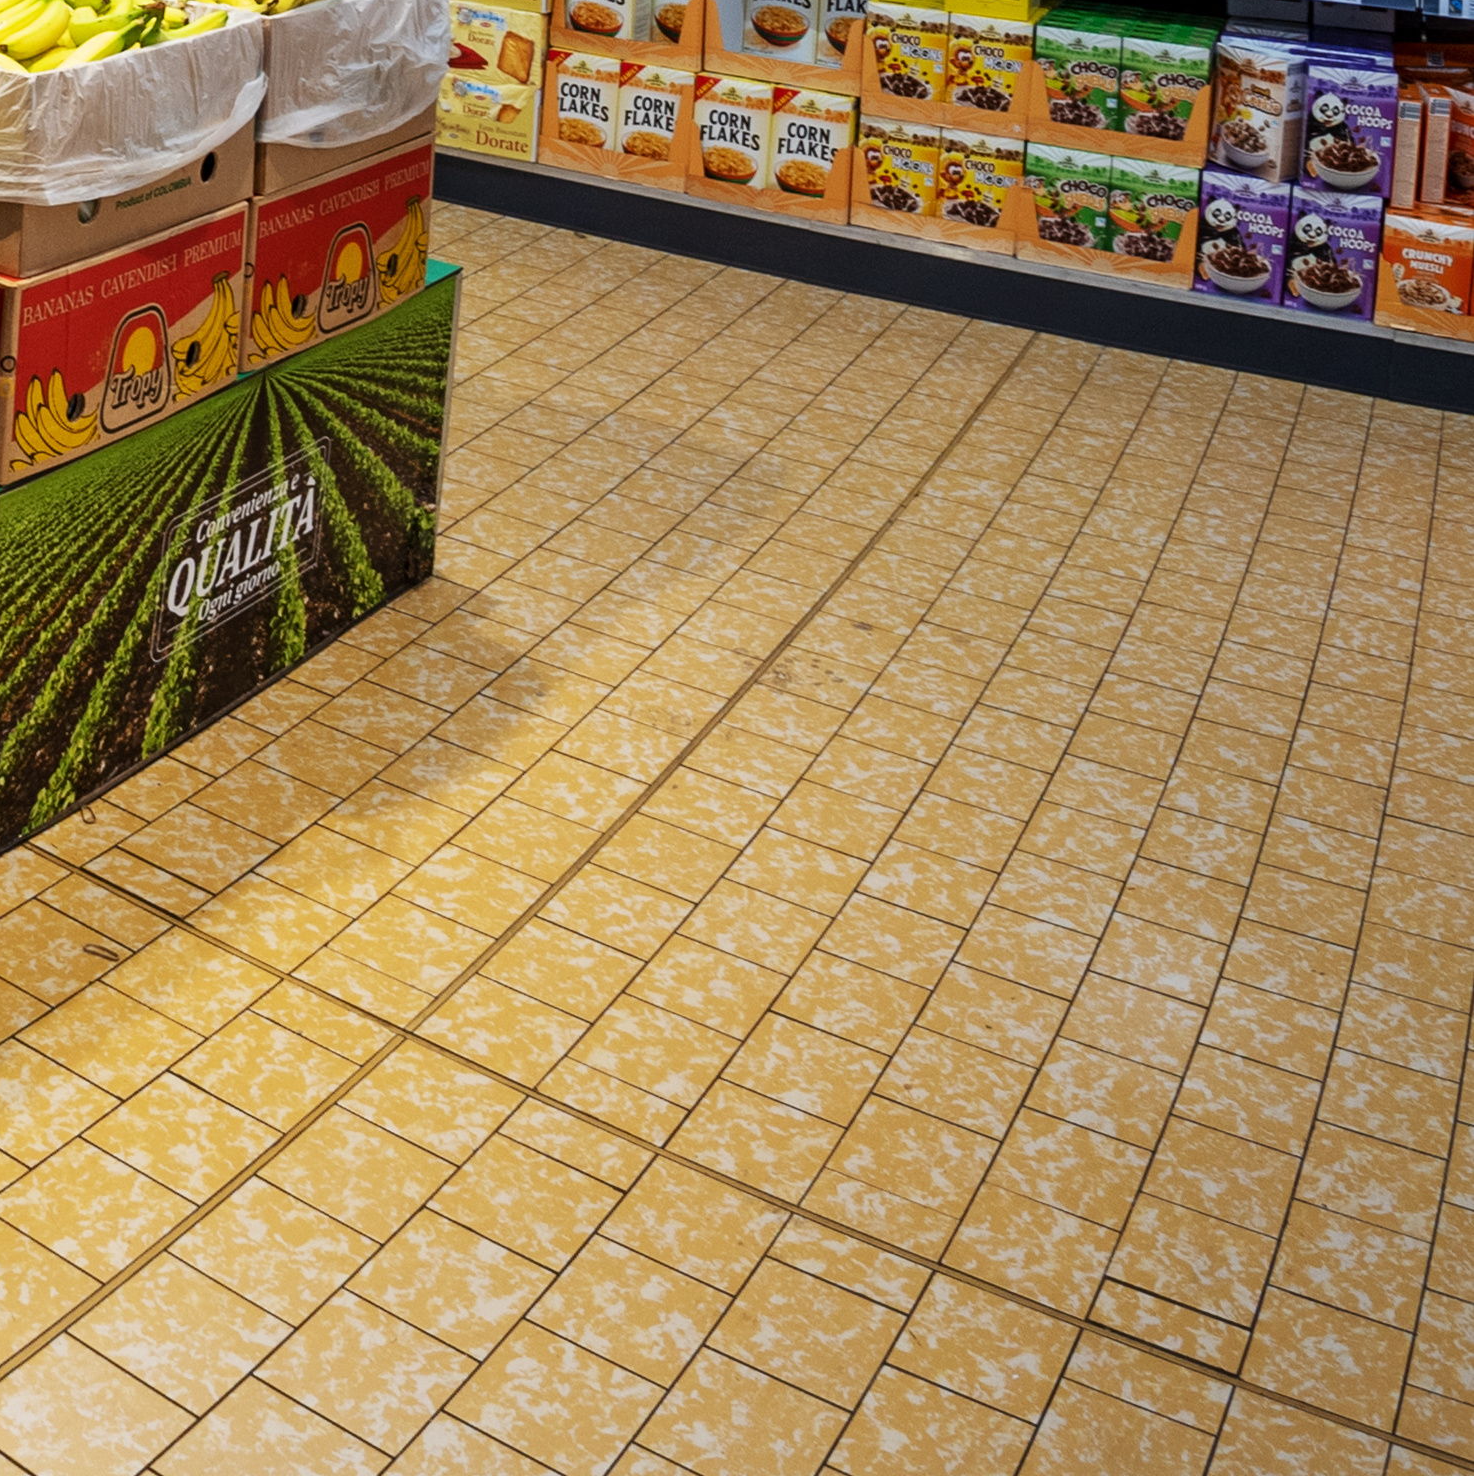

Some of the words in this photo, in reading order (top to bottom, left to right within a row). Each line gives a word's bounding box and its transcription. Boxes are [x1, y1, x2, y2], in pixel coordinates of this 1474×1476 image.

[890, 33, 921, 46] CHOCO
[974, 44, 1005, 58] CHOCO
[1344, 104, 1381, 118] COCOA
[1358, 116, 1393, 130] HOOPS
[883, 144, 912, 158] CHOCO
[115, 194, 143, 210] Product
[153, 178, 192, 198] COLOMBIA
[258, 205, 315, 239] BANANAS
[319, 181, 380, 215] CAVENDISH
[384, 159, 430, 189] PREMIUM
[1237, 210, 1273, 225] COCOA
[1249, 224, 1284, 239] HOOPS
[1327, 226, 1364, 240] COCOA
[1340, 238, 1376, 253] HOOPS
[1402, 248, 1453, 266] CRUNCHY
[1410, 260, 1444, 274] MUESLI
[22, 284, 95, 326] BANANAS
[101, 255, 179, 299] CAVENDISH
[184, 229, 243, 267] PREMIUM
[325, 272, 369, 314] Tropy
[111, 363, 163, 409] Tropy
[196, 480, 288, 543] Convenienza
[291, 474, 300, 491] e
[167, 475, 316, 617] QUALITÀ
[198, 584, 234, 621] Ogni
[234, 561, 280, 605] giorno
